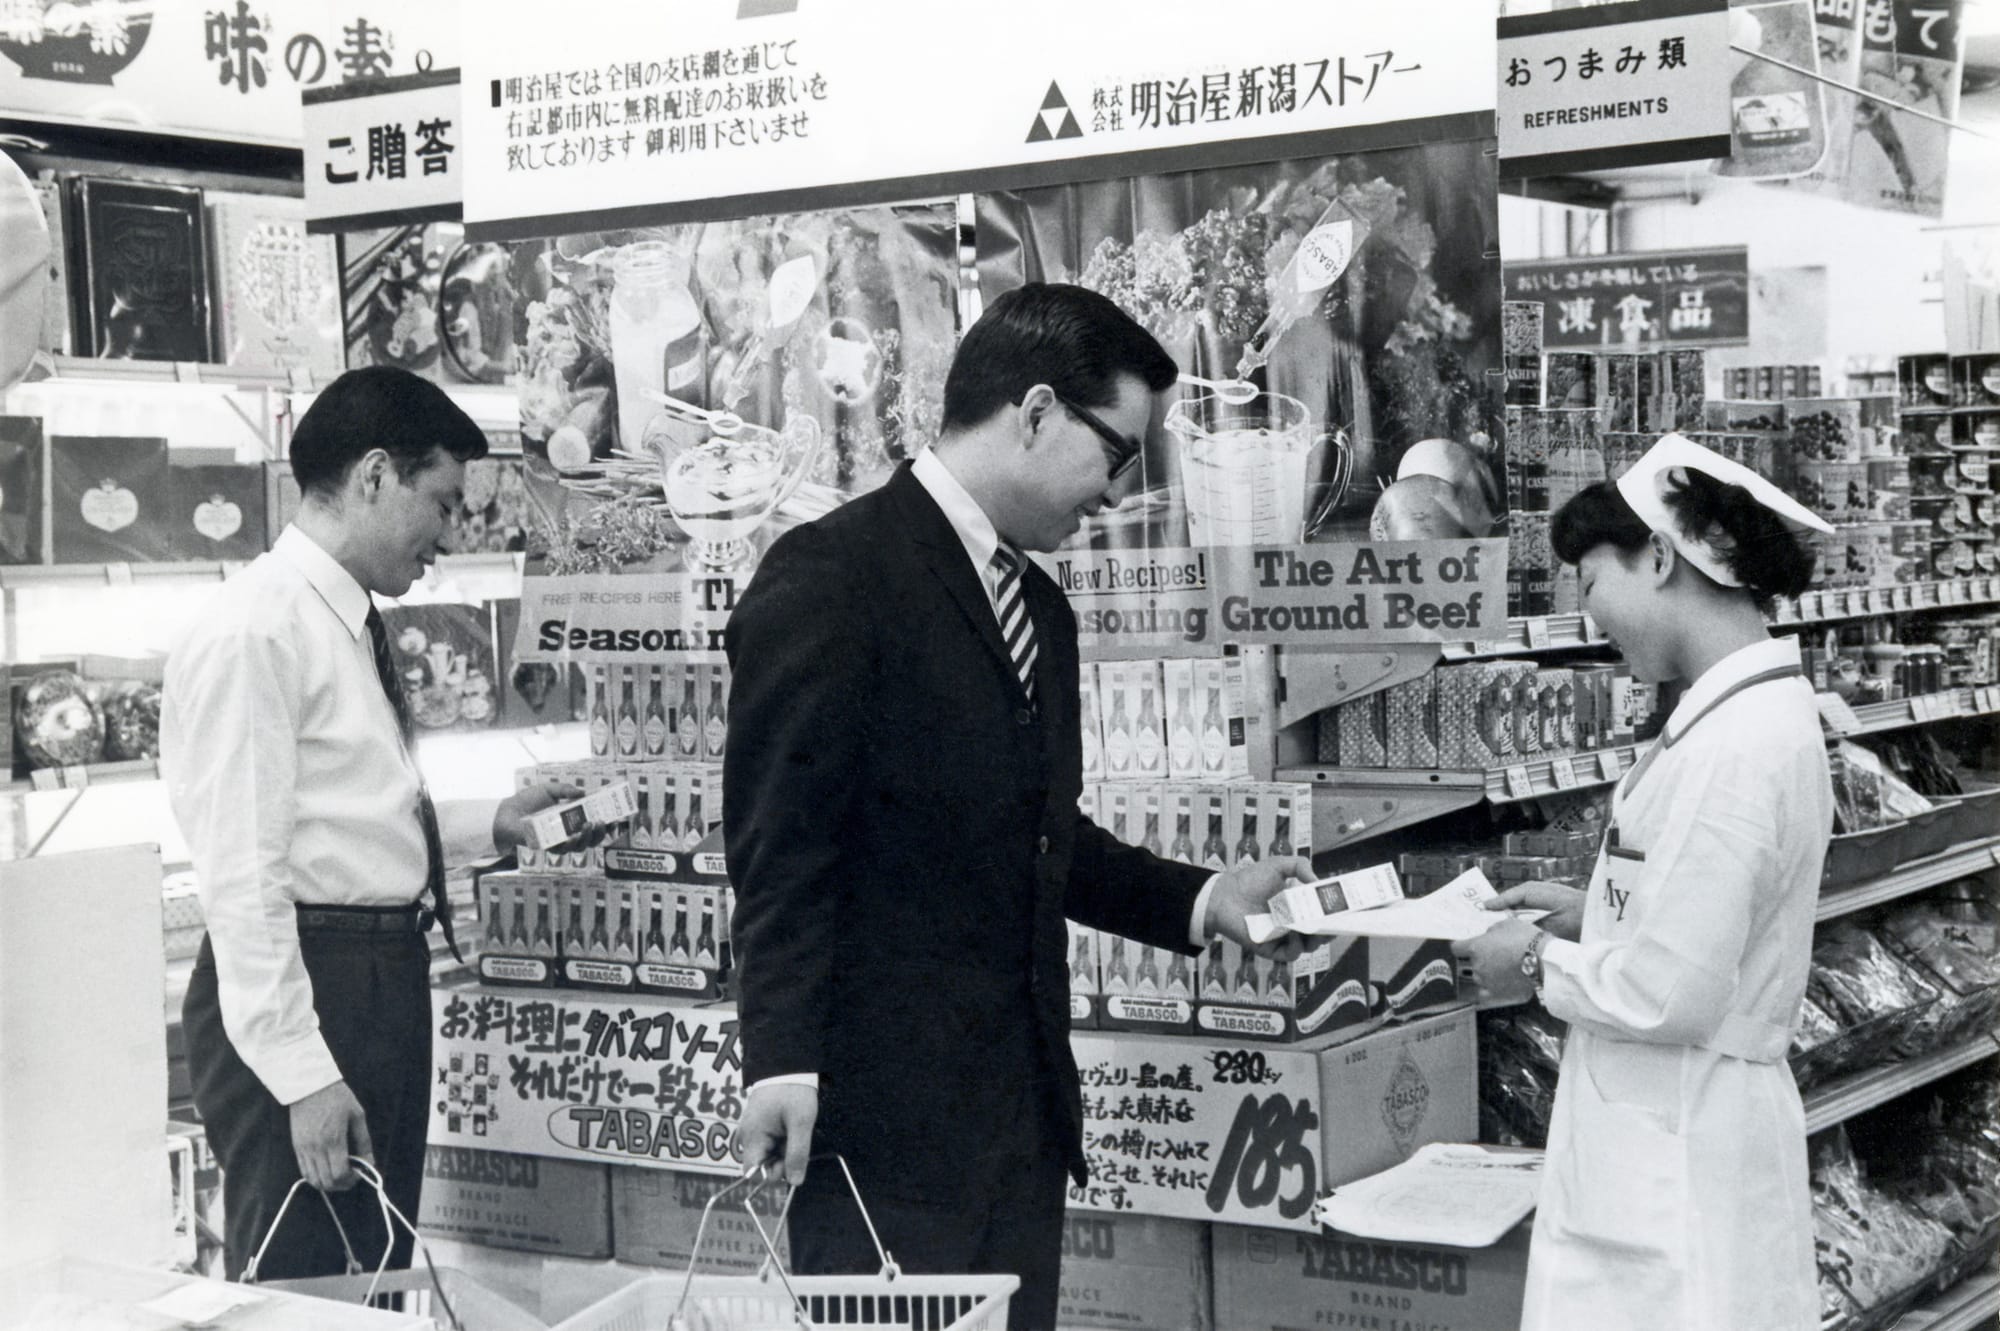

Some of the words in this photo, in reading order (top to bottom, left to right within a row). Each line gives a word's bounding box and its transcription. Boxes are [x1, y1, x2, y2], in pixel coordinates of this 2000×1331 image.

[1505, 35, 1687, 88] おつまみ類
[1091, 84, 1125, 108] 株式
[1130, 49, 1422, 130] 明治屋新潟ストアー
[1091, 110, 1125, 134] 会社
[1524, 96, 1669, 130] REFRESHMENTS
[325, 117, 456, 184] ご贈答
[1058, 559, 1101, 591] New
[1108, 553, 1206, 592] Recipes!
[1254, 551, 1333, 588] The
[1346, 548, 1423, 585] Art
[1438, 546, 1480, 583] of
[579, 592, 641, 605] RECIPES
[650, 591, 682, 604] HERE
[1222, 594, 1369, 632] Ground
[1383, 592, 1482, 629] Beef
[1351, 1292, 1413, 1311] BRAND
